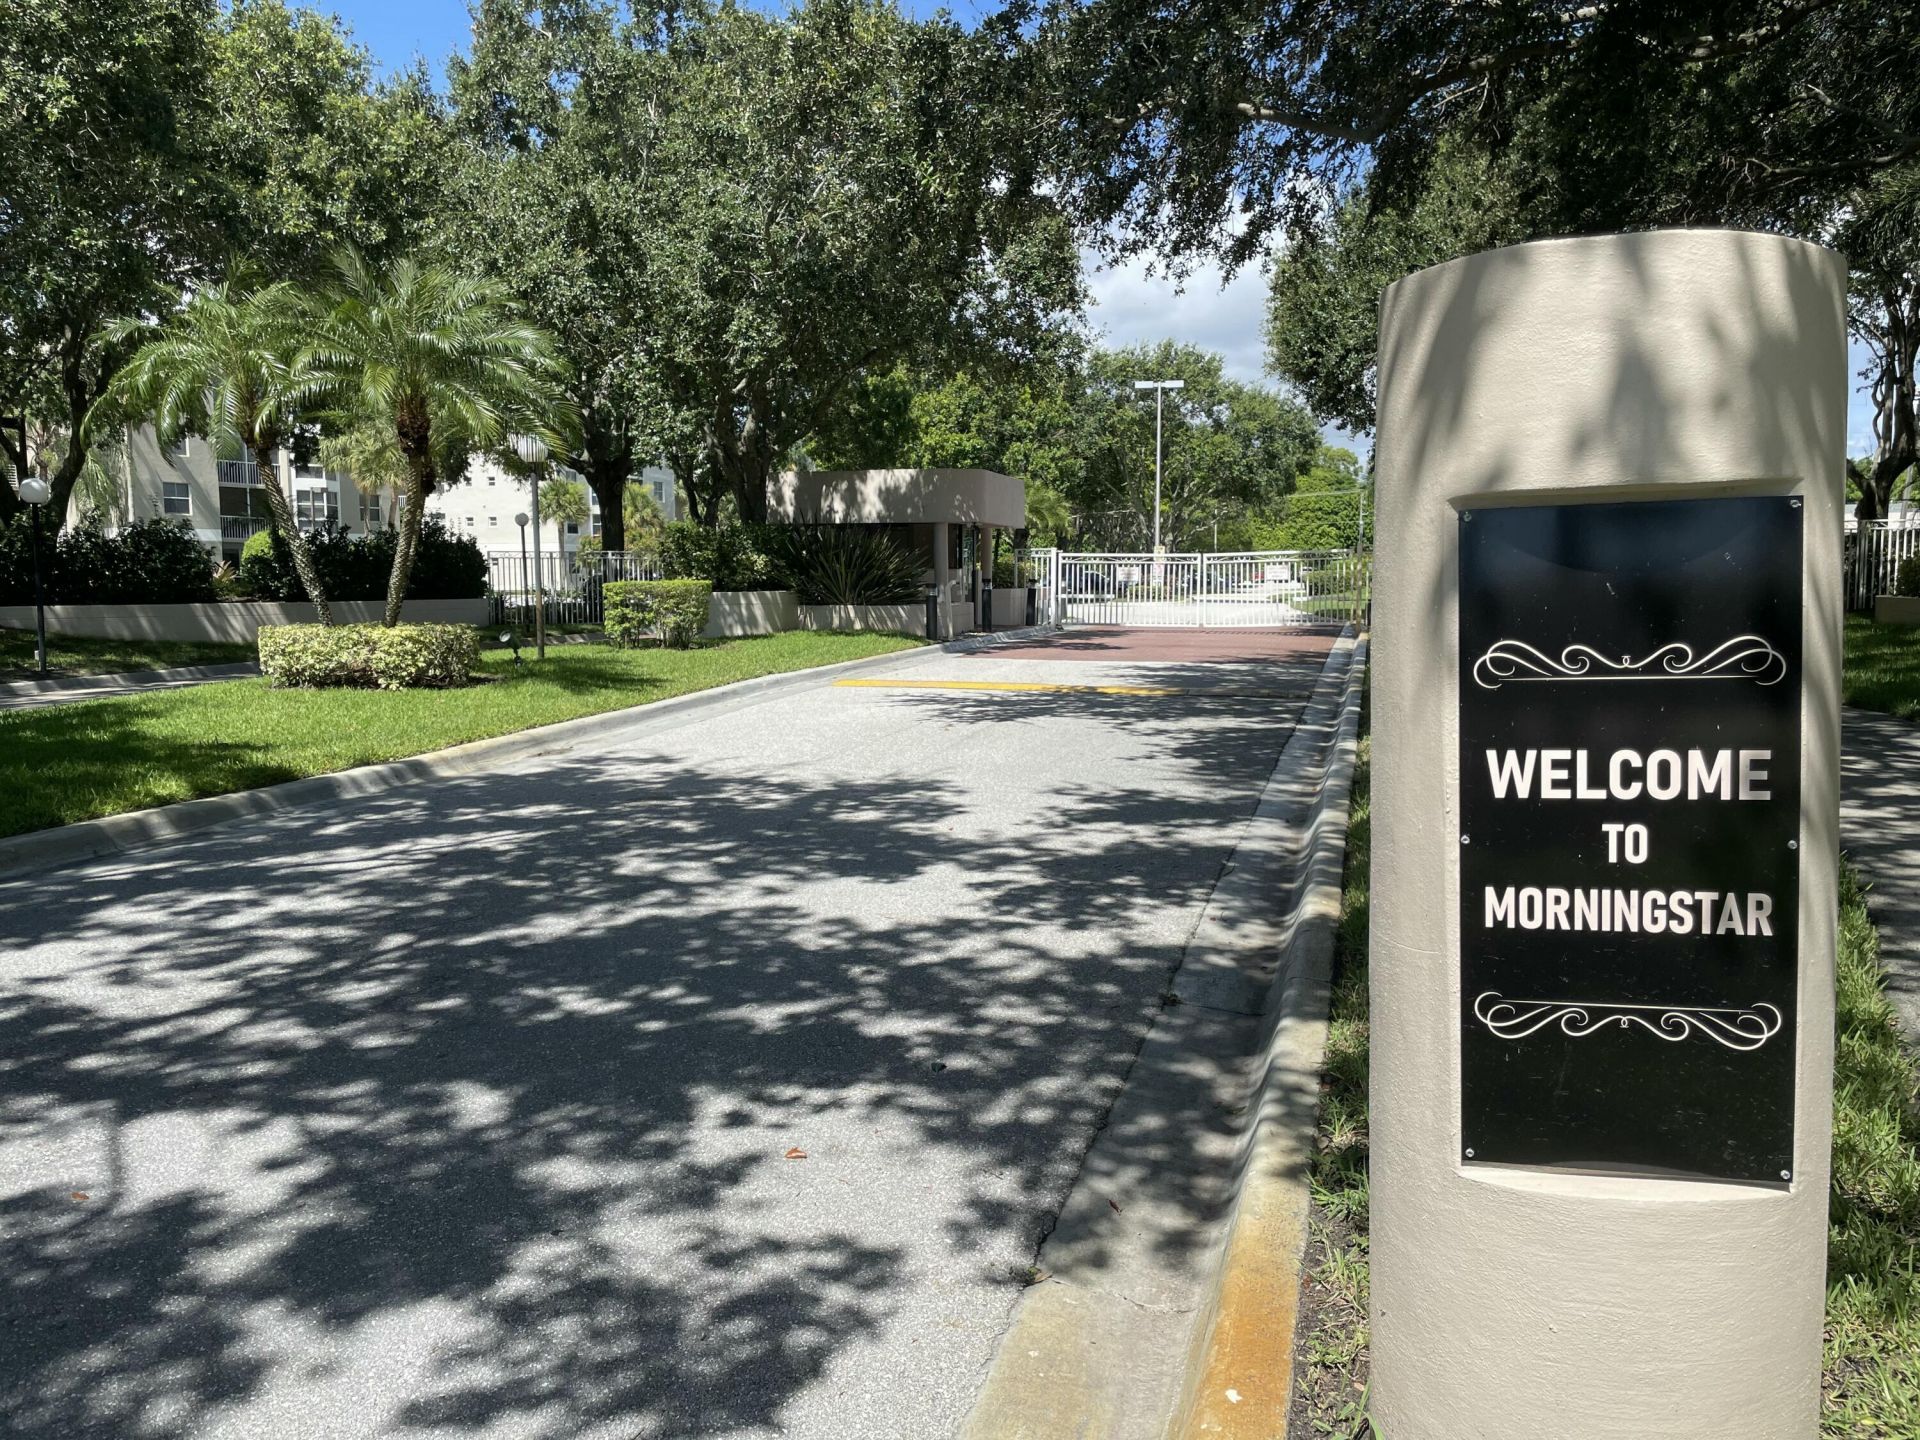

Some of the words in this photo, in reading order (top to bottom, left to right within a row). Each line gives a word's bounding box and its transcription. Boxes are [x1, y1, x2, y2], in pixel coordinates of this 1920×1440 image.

[1486, 748, 1772, 800] WELCOME
[1602, 823, 1648, 864] TO
[1484, 886, 1773, 936] MORNINGSTAR
